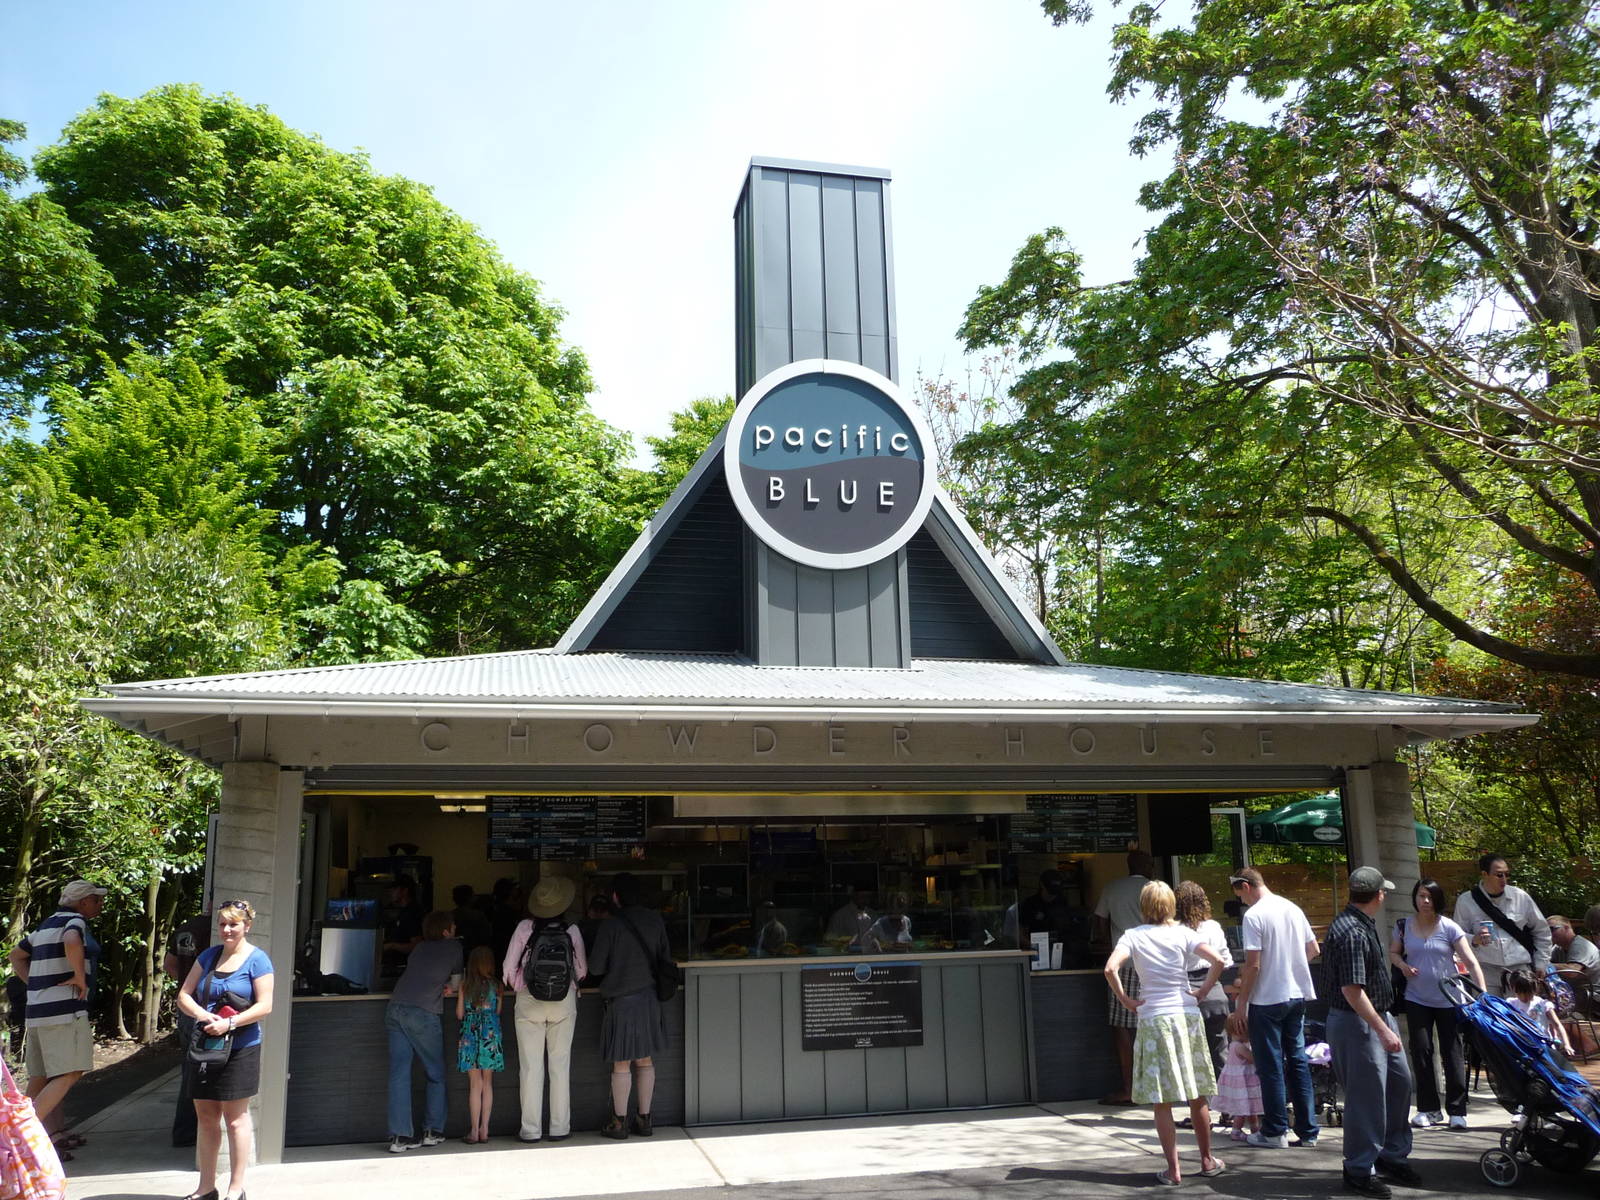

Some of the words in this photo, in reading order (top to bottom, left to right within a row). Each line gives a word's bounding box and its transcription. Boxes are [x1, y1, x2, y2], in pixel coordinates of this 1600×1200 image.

[755, 423, 909, 452] pacific
[768, 476, 895, 506] BLUE
[420, 721, 913, 757] CHOWDER
[1005, 727, 1276, 757] HOUSE
